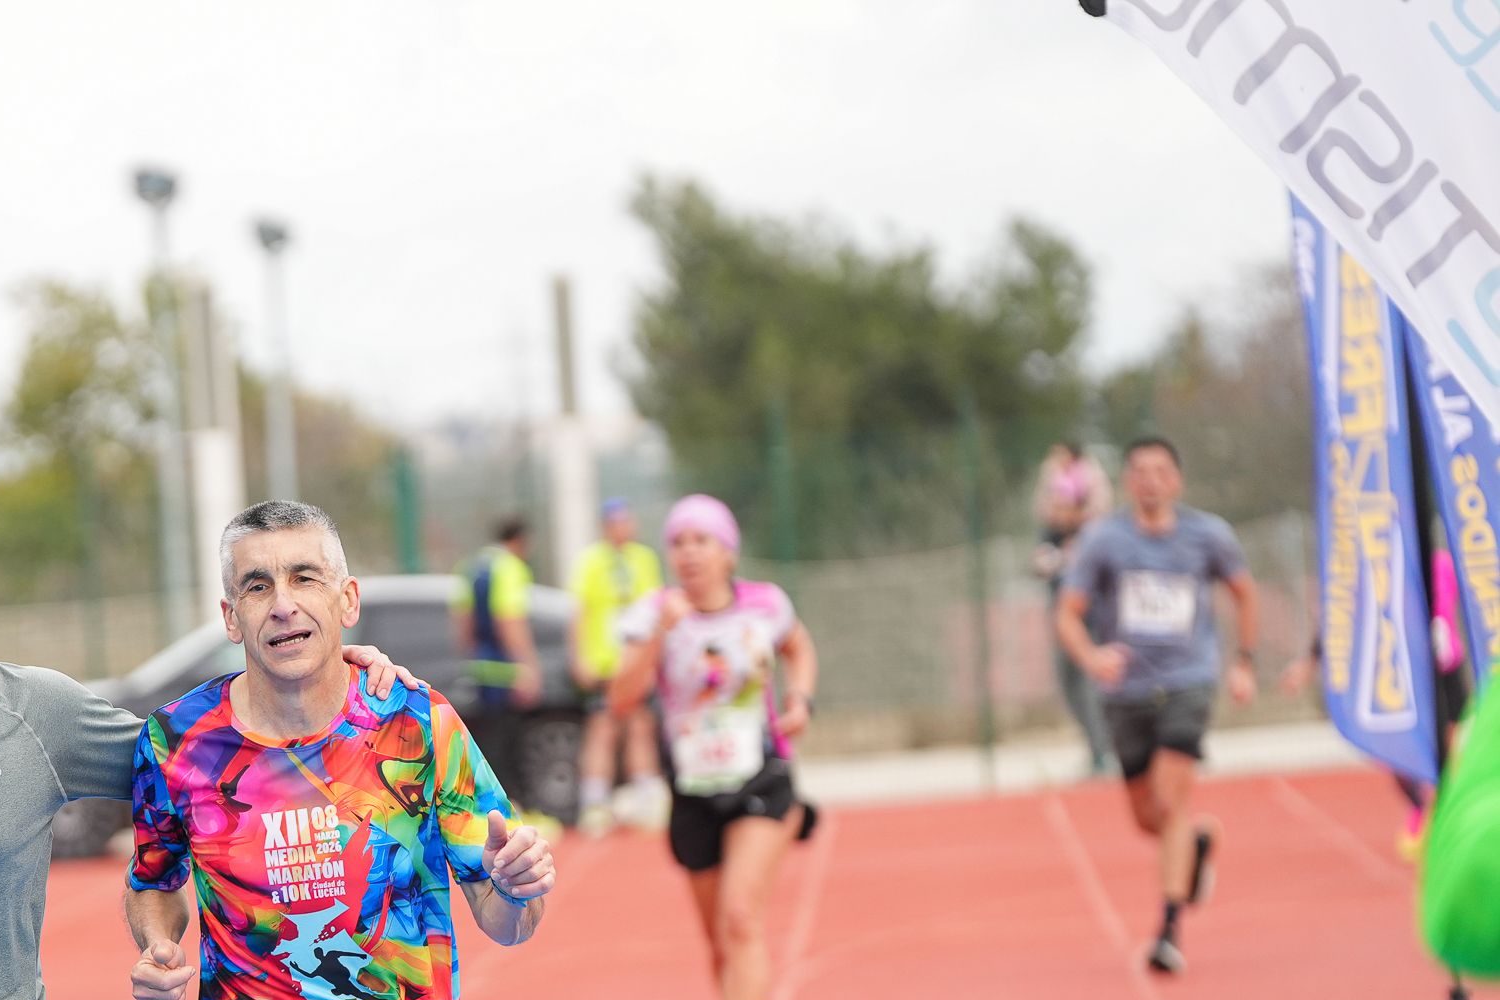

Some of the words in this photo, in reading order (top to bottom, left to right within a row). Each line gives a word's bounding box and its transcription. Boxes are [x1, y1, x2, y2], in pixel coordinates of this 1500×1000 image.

[260, 808, 312, 850] XII
[312, 804, 339, 830] 08
[314, 830, 340, 841] MARZO
[264, 845, 317, 868] MEDIA
[316, 841, 342, 855] 2026
[266, 857, 345, 886] MARATÓN
[271, 890, 281, 904] &
[280, 883, 312, 903] 10K
[312, 880, 336, 890] Ciudad
[313, 887, 346, 899] LUCENA
